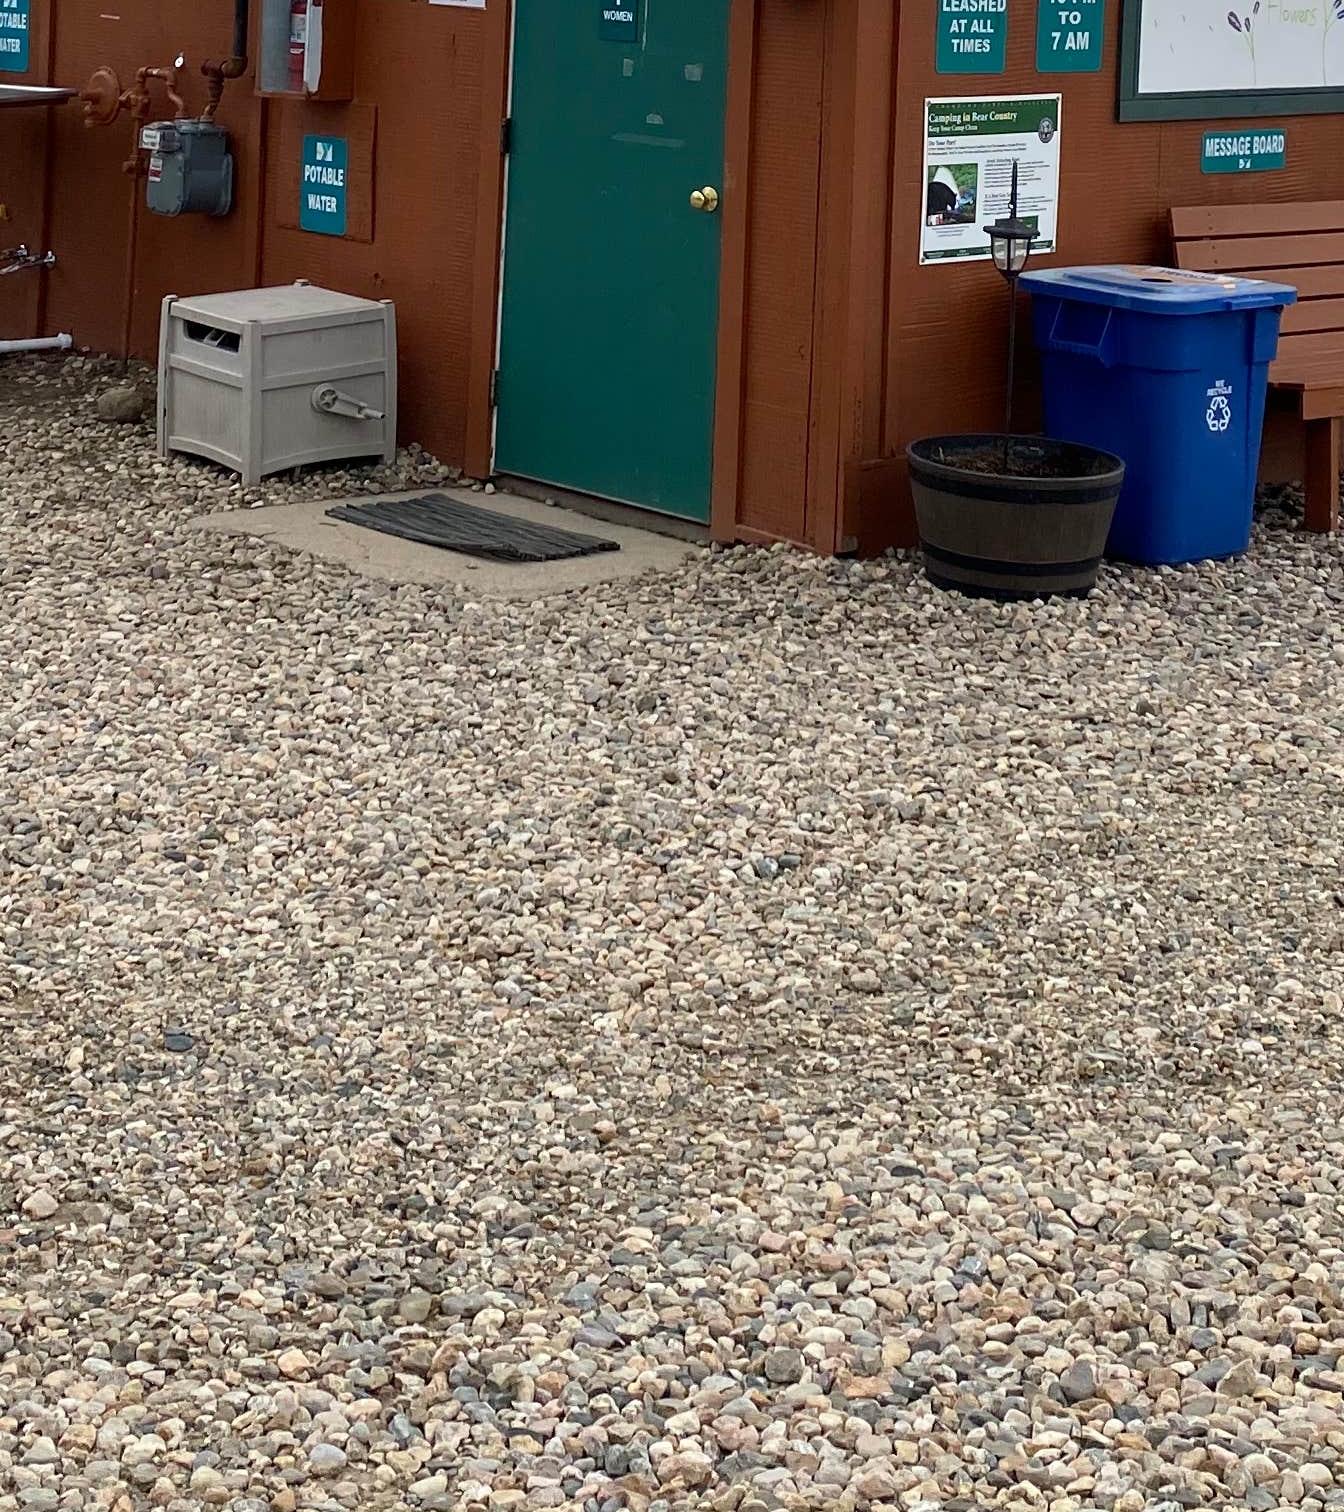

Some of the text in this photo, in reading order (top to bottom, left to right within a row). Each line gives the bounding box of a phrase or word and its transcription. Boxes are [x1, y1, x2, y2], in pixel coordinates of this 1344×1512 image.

[603, 10, 633, 22] WOMEN
[1058, 11, 1082, 25] TO
[949, 19, 994, 34] AT ALL
[951, 39, 991, 53] TIMES
[1051, 31, 1090, 51] 7 AM
[928, 111, 1017, 124] Camping in Bear Country
[1205, 134, 1285, 157] MESSAGE BOARD
[304, 164, 344, 187] POTABLE
[307, 193, 337, 213] WATER
